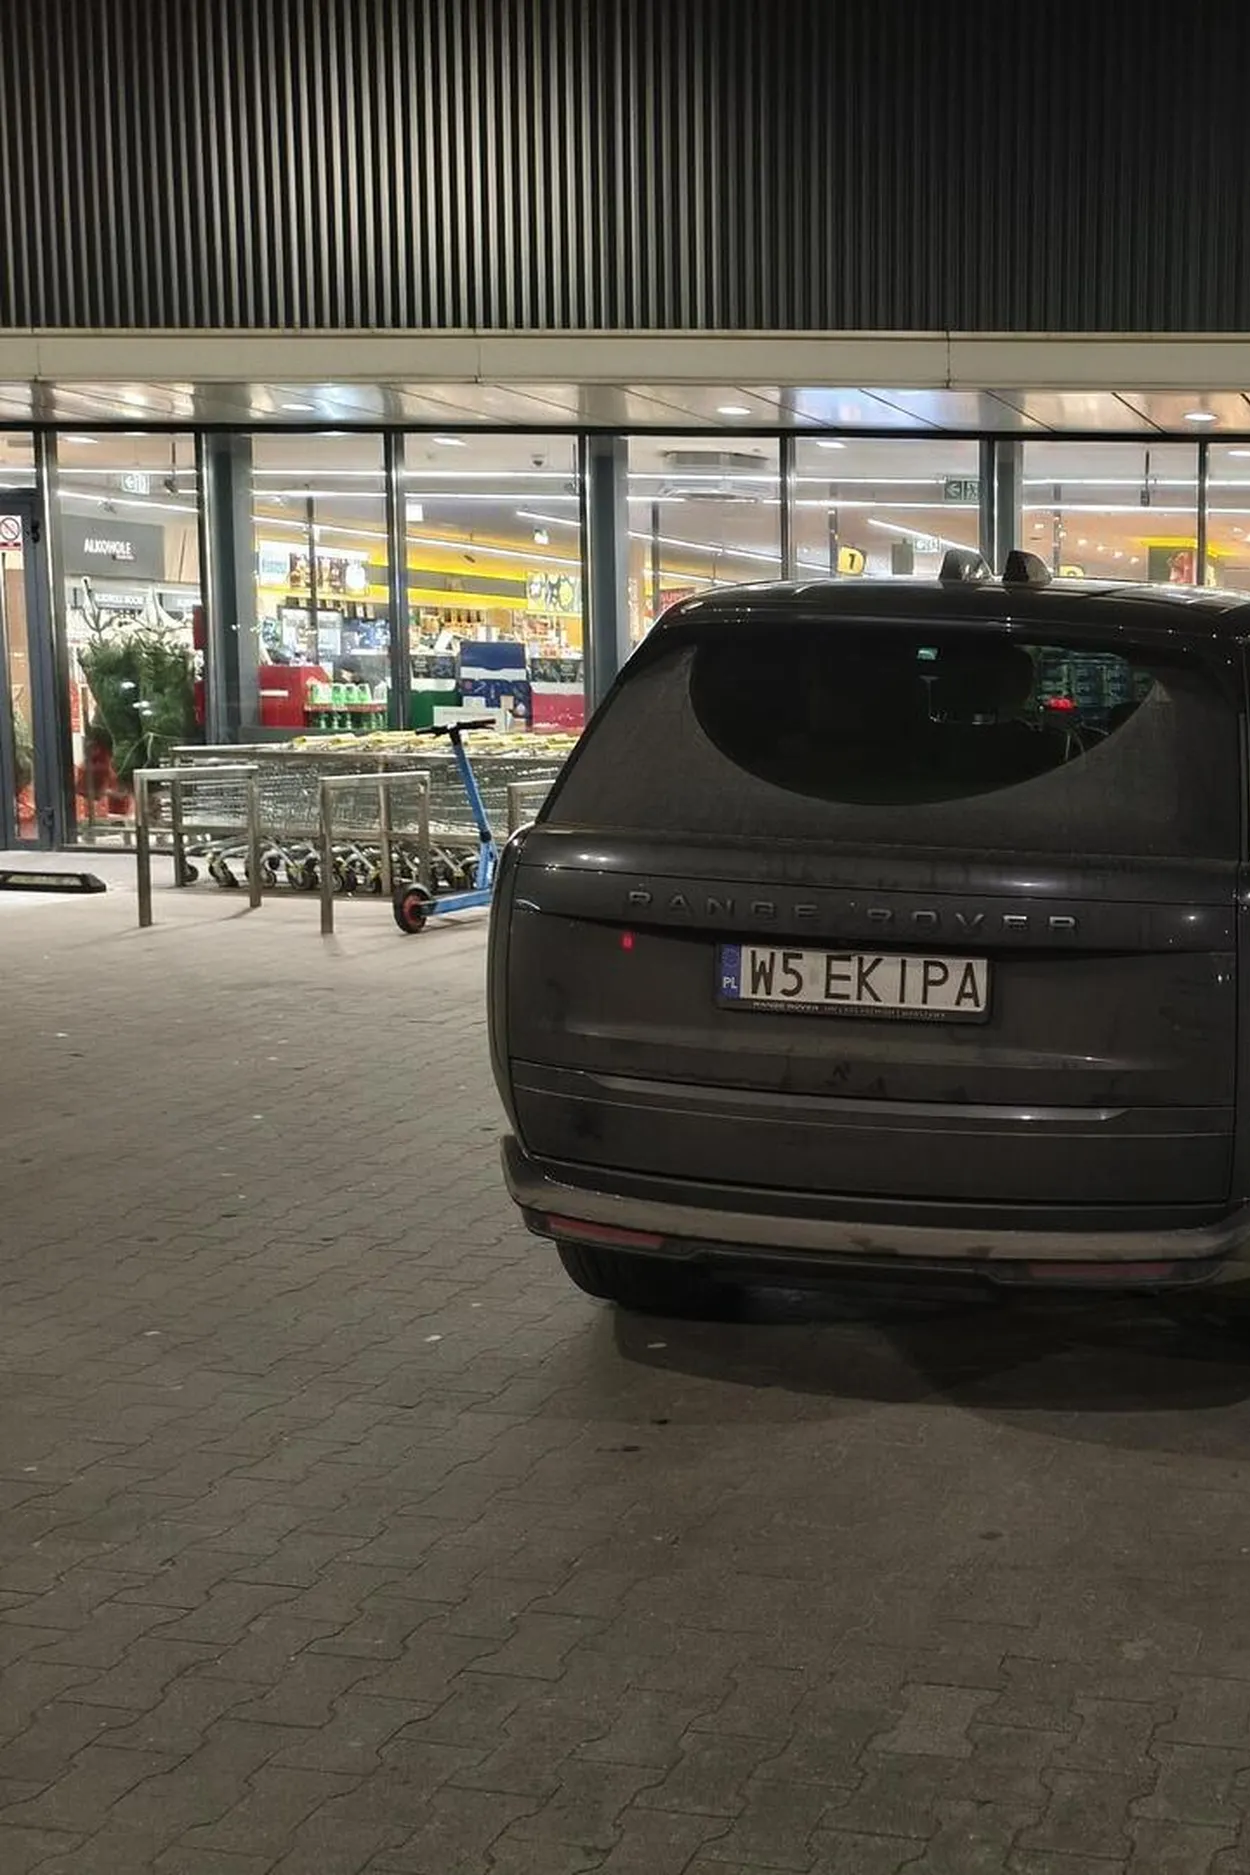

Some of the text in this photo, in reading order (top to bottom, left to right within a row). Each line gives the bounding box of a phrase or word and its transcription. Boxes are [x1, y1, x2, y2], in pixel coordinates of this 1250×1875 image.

[83, 538, 132, 554] ALKOHOLE
[848, 553, 857, 570] 1
[628, 890, 1077, 932] RANGE ROVER
[722, 976, 738, 990] PL
[750, 950, 981, 1008] W5 EKIPA
